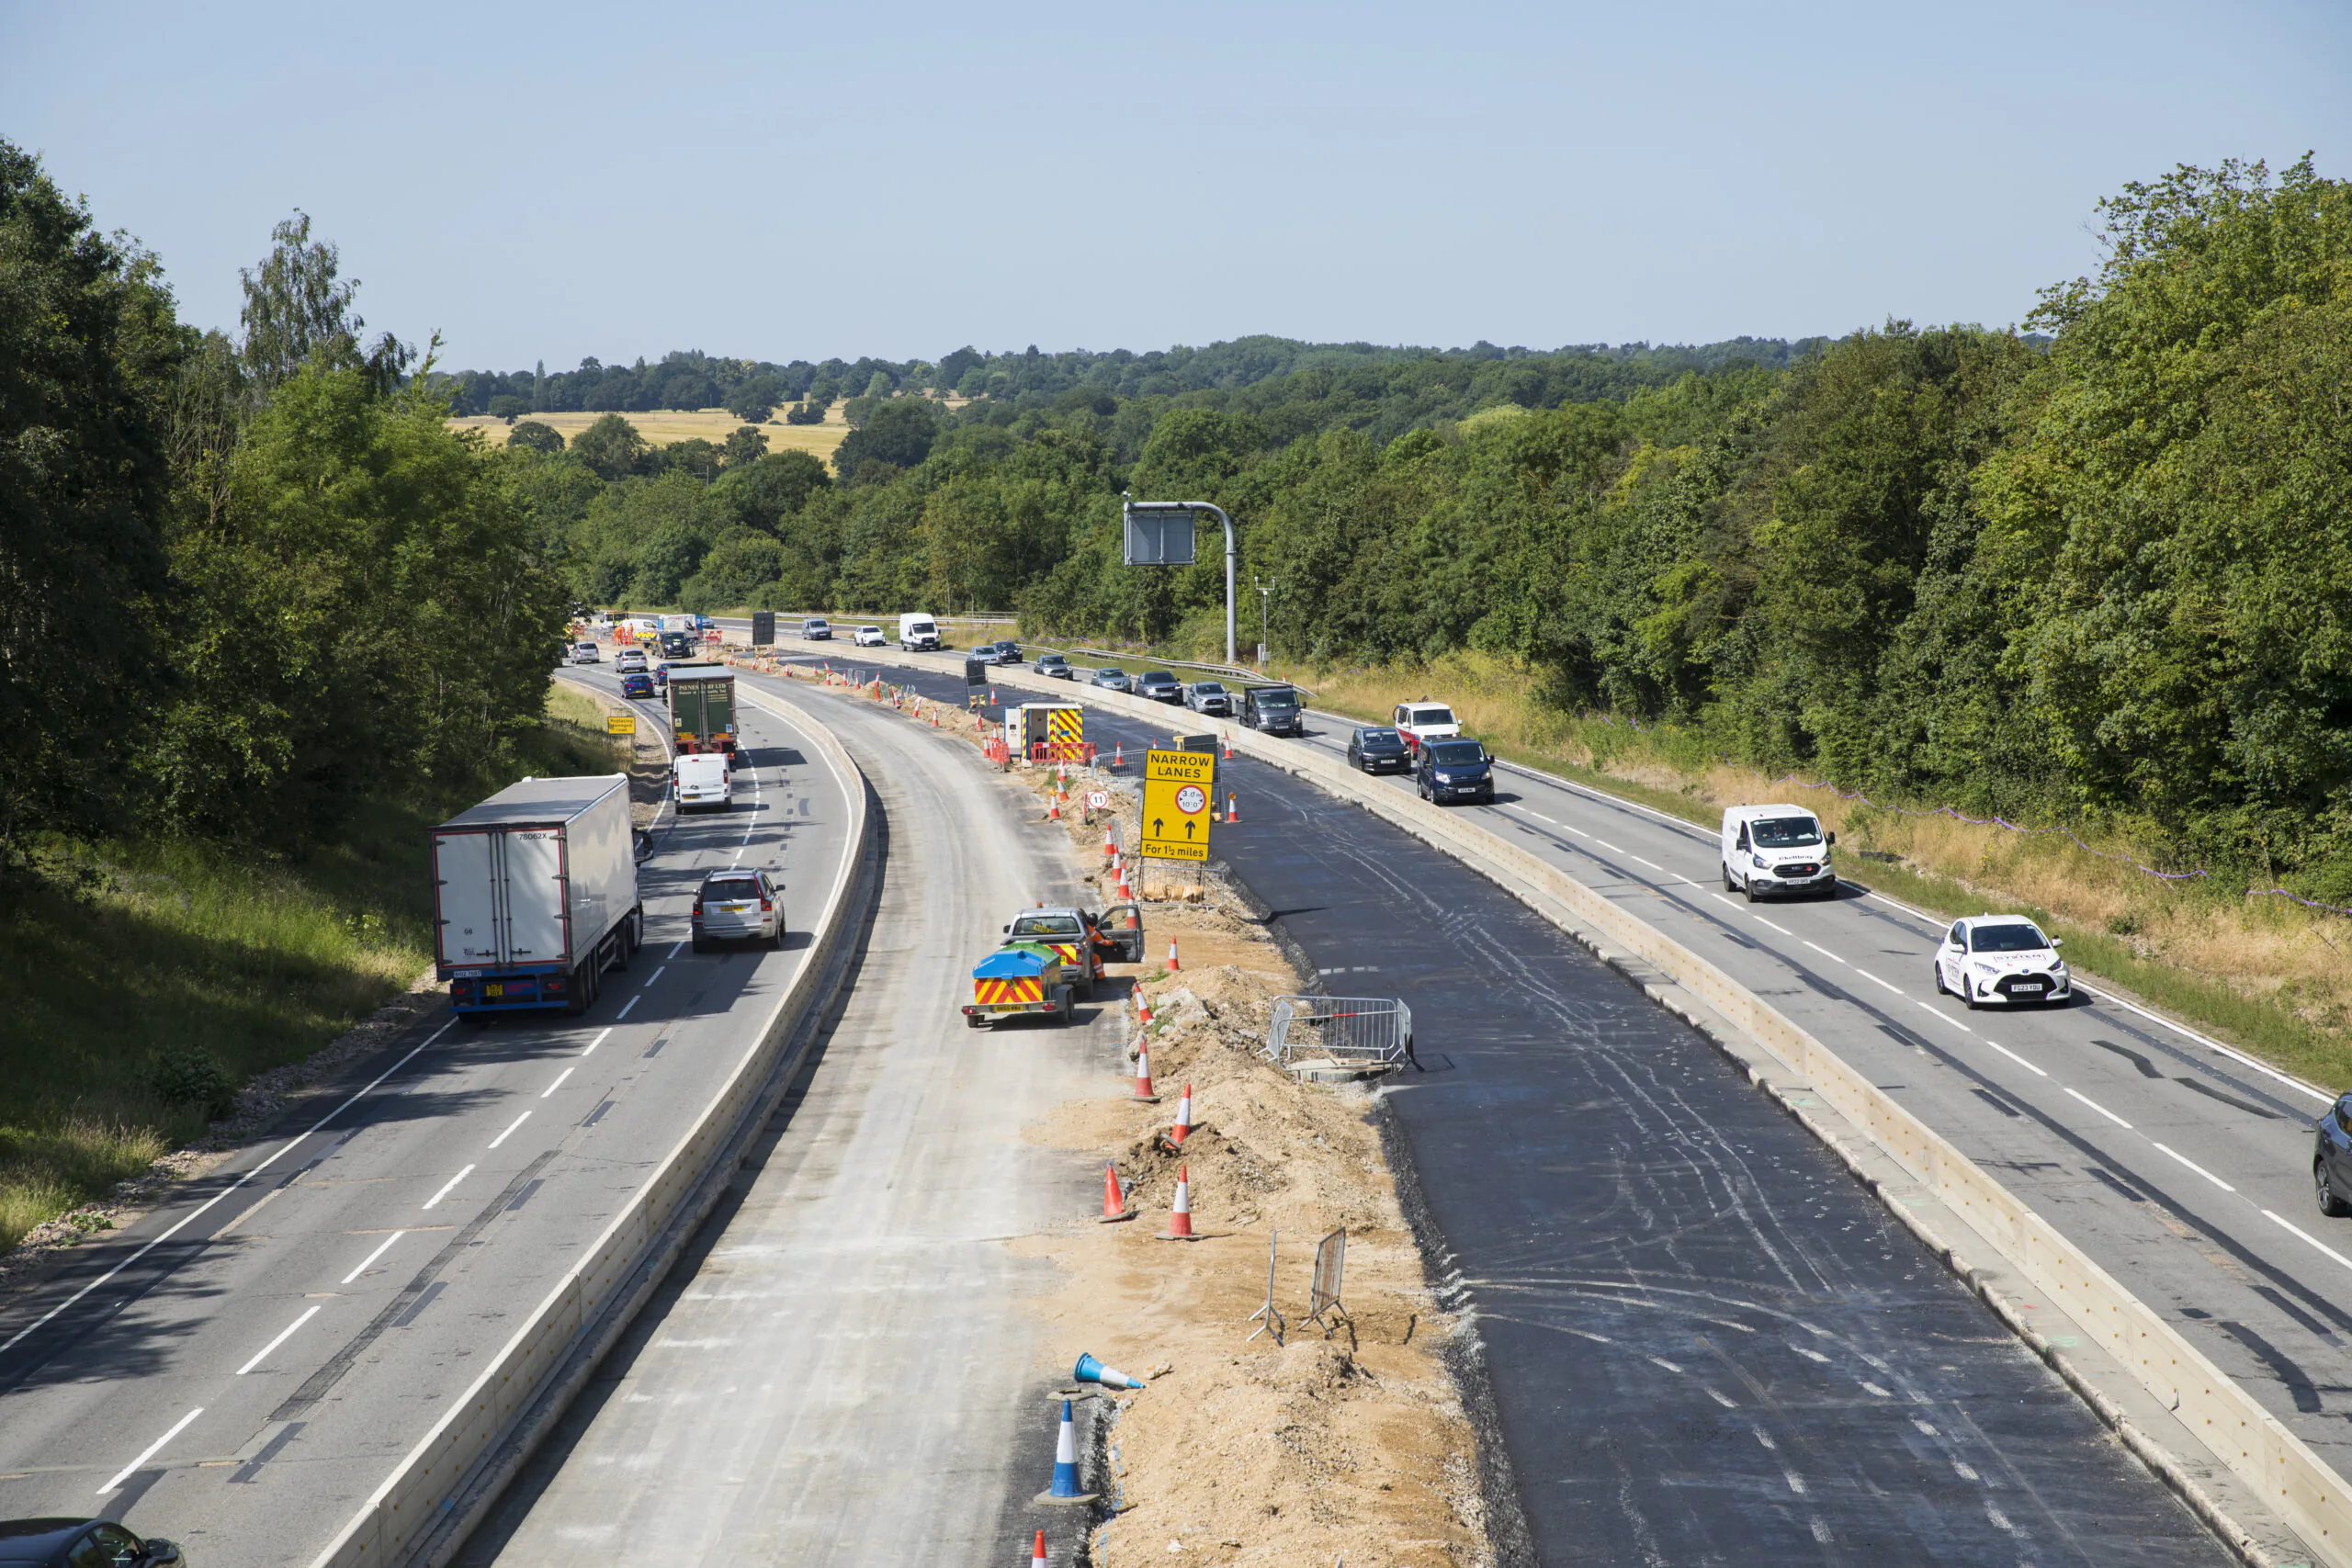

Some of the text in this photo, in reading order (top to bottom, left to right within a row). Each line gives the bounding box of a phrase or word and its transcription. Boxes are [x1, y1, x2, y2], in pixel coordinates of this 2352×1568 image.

[1150, 754, 1210, 767] NARROW
[1158, 766, 1201, 779] LANES
[519, 832, 547, 840] 78062X
[1145, 843, 1161, 854] For
[1177, 847, 1204, 858] miles
